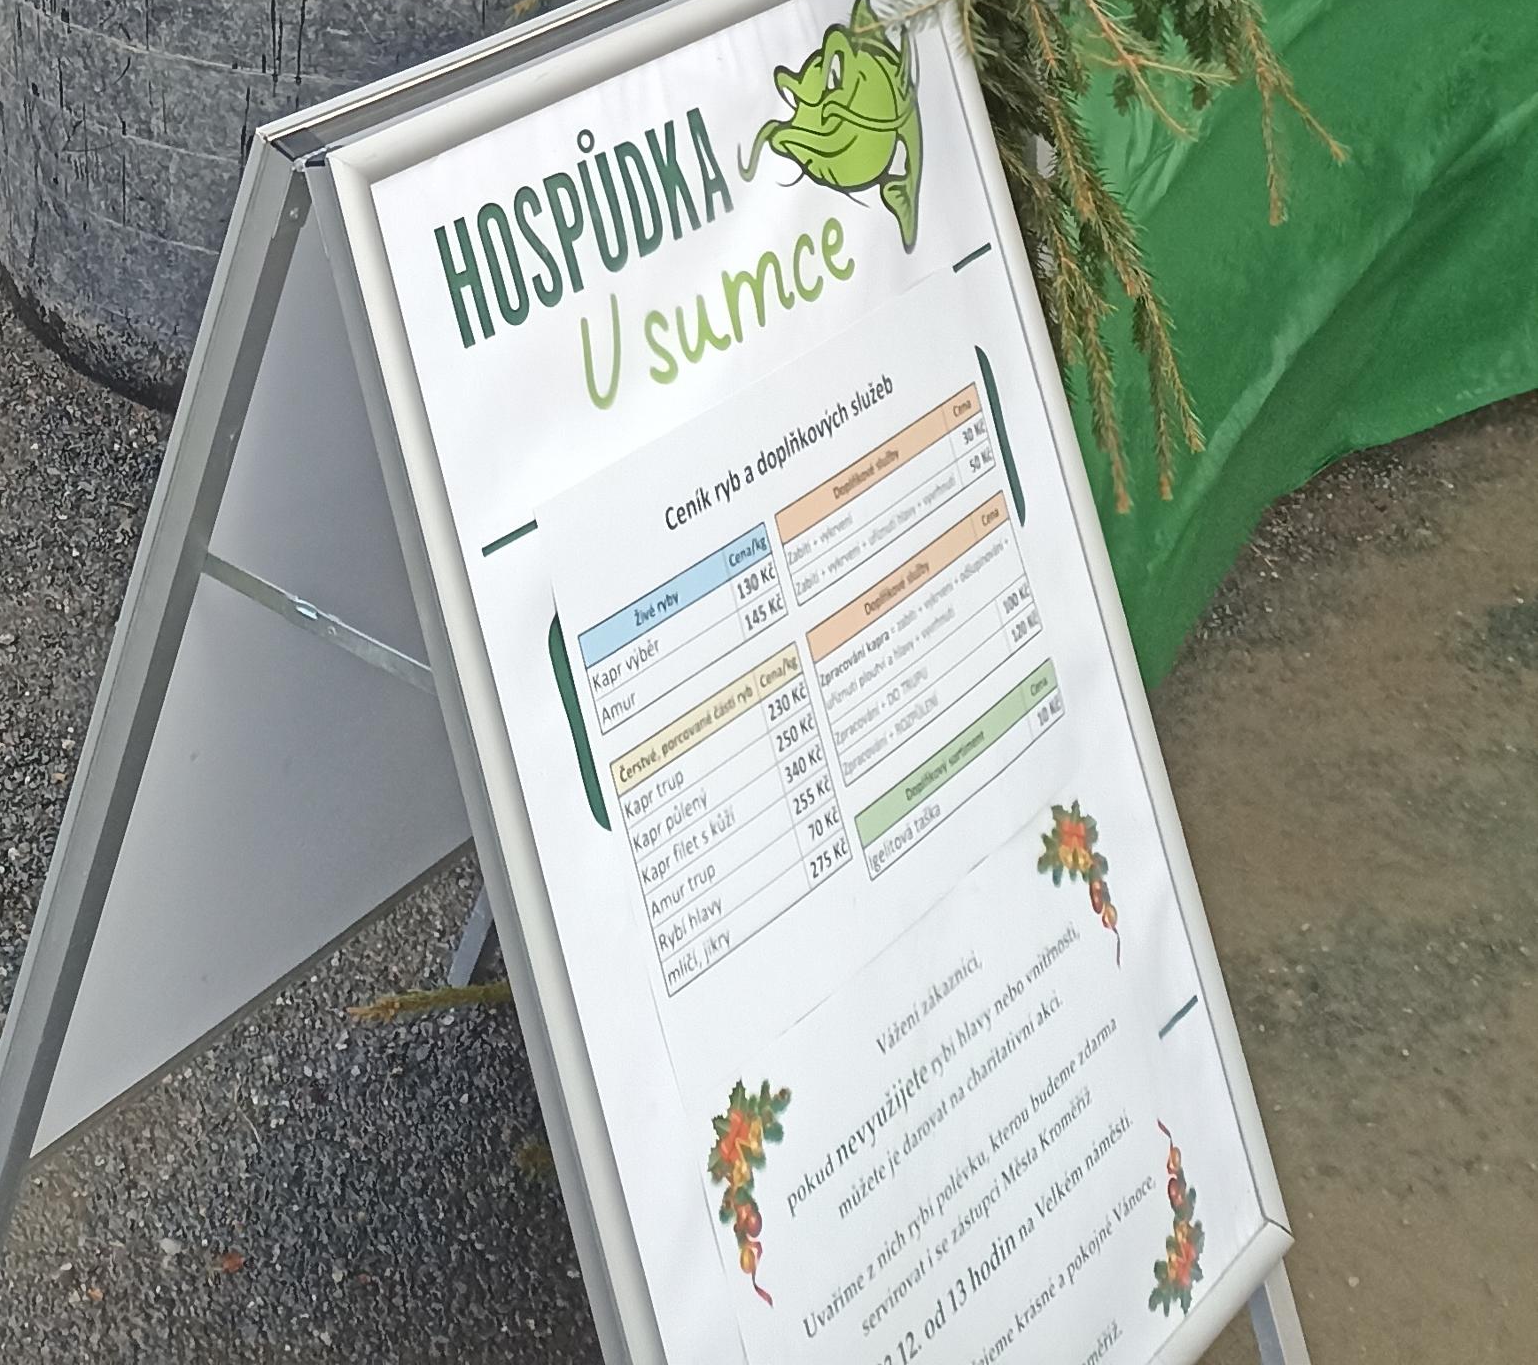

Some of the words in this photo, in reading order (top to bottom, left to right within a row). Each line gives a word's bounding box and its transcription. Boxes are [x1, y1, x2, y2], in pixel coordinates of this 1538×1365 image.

[434, 107, 734, 349] HOSPŮDKA
[577, 294, 622, 411] U
[644, 215, 856, 386] sumce
[664, 487, 713, 531] Ceník
[714, 469, 741, 503] ryb
[743, 465, 755, 485] a
[756, 402, 850, 476] doplňkových
[850, 374, 894, 417] služeb
[592, 663, 622, 692] Kapr
[625, 639, 659, 671] výběr
[736, 572, 760, 600] 130
[759, 561, 776, 584] Kč
[633, 604, 656, 627] Živé
[656, 591, 679, 613] ryby
[728, 536, 768, 568] Cena/kg
[602, 692, 636, 726] Amur
[744, 604, 767, 632] 145
[767, 592, 784, 615] Kč
[736, 685, 754, 704] ryb
[759, 656, 799, 689] Cena/kg
[623, 789, 654, 820] Kapr
[655, 770, 684, 798] trup
[767, 693, 791, 722] 230
[791, 681, 807, 705] Kč
[632, 822, 661, 853] Kapr
[665, 787, 708, 835] půlený
[775, 724, 799, 753] 250
[799, 712, 815, 735] Kč
[641, 855, 671, 885] Kapr
[672, 834, 700, 863] filet
[701, 830, 709, 845] s
[709, 806, 736, 837] kůží
[784, 756, 807, 784] 340
[807, 743, 823, 766] Kč
[651, 884, 685, 920] Amur
[687, 864, 716, 892] trup
[792, 787, 816, 816] 255
[815, 774, 831, 797] Kč
[657, 918, 688, 952] Rybí
[687, 897, 722, 930] hlavy
[807, 818, 824, 841] 70
[823, 805, 840, 829] Kč
[703, 930, 731, 965] jikry
[809, 850, 832, 879] 275
[832, 837, 848, 860] Kč
[786, 1153, 835, 1218] pokud
[835, 1065, 928, 1166] nevyužijete
[930, 1040, 957, 1078] rybí
[955, 1008, 992, 1048] hlavy
[993, 979, 1025, 1015] nebo
[875, 1003, 921, 1055] Vážení
[802, 1274, 865, 1339] Uvaříme
[866, 1263, 875, 1281] z
[876, 1229, 907, 1270] nich
[907, 1197, 935, 1240] rybí
[935, 1151, 990, 1217] polévku,
[988, 1108, 1030, 1153] kterou
[1029, 1059, 1076, 1114] budeme
[1077, 1018, 1117, 1066] zdarma
[838, 1164, 886, 1220] můžete
[886, 1150, 902, 1178] je
[902, 1099, 948, 1156] darovat
[949, 1085, 966, 1109] na
[966, 1014, 1036, 1092] charitativní
[1036, 996, 1063, 1027] akci.
[924, 1298, 947, 1340] od
[947, 1278, 967, 1313] 13
[967, 1234, 1017, 1293] hodin
[1018, 1217, 1035, 1242] na
[1034, 1165, 1084, 1219] Velkém
[1084, 1116, 1134, 1171] náměstí.
[926, 1248, 934, 1268] i
[935, 1238, 949, 1261] se
[951, 1178, 1001, 1244] zástupci
[1000, 1146, 1039, 1191] Města
[1014, 1277, 1056, 1334] krásné
[1058, 1273, 1066, 1289] a
[1066, 1215, 1113, 1286] pokojné
[1111, 1175, 1156, 1223] Vánoce,
